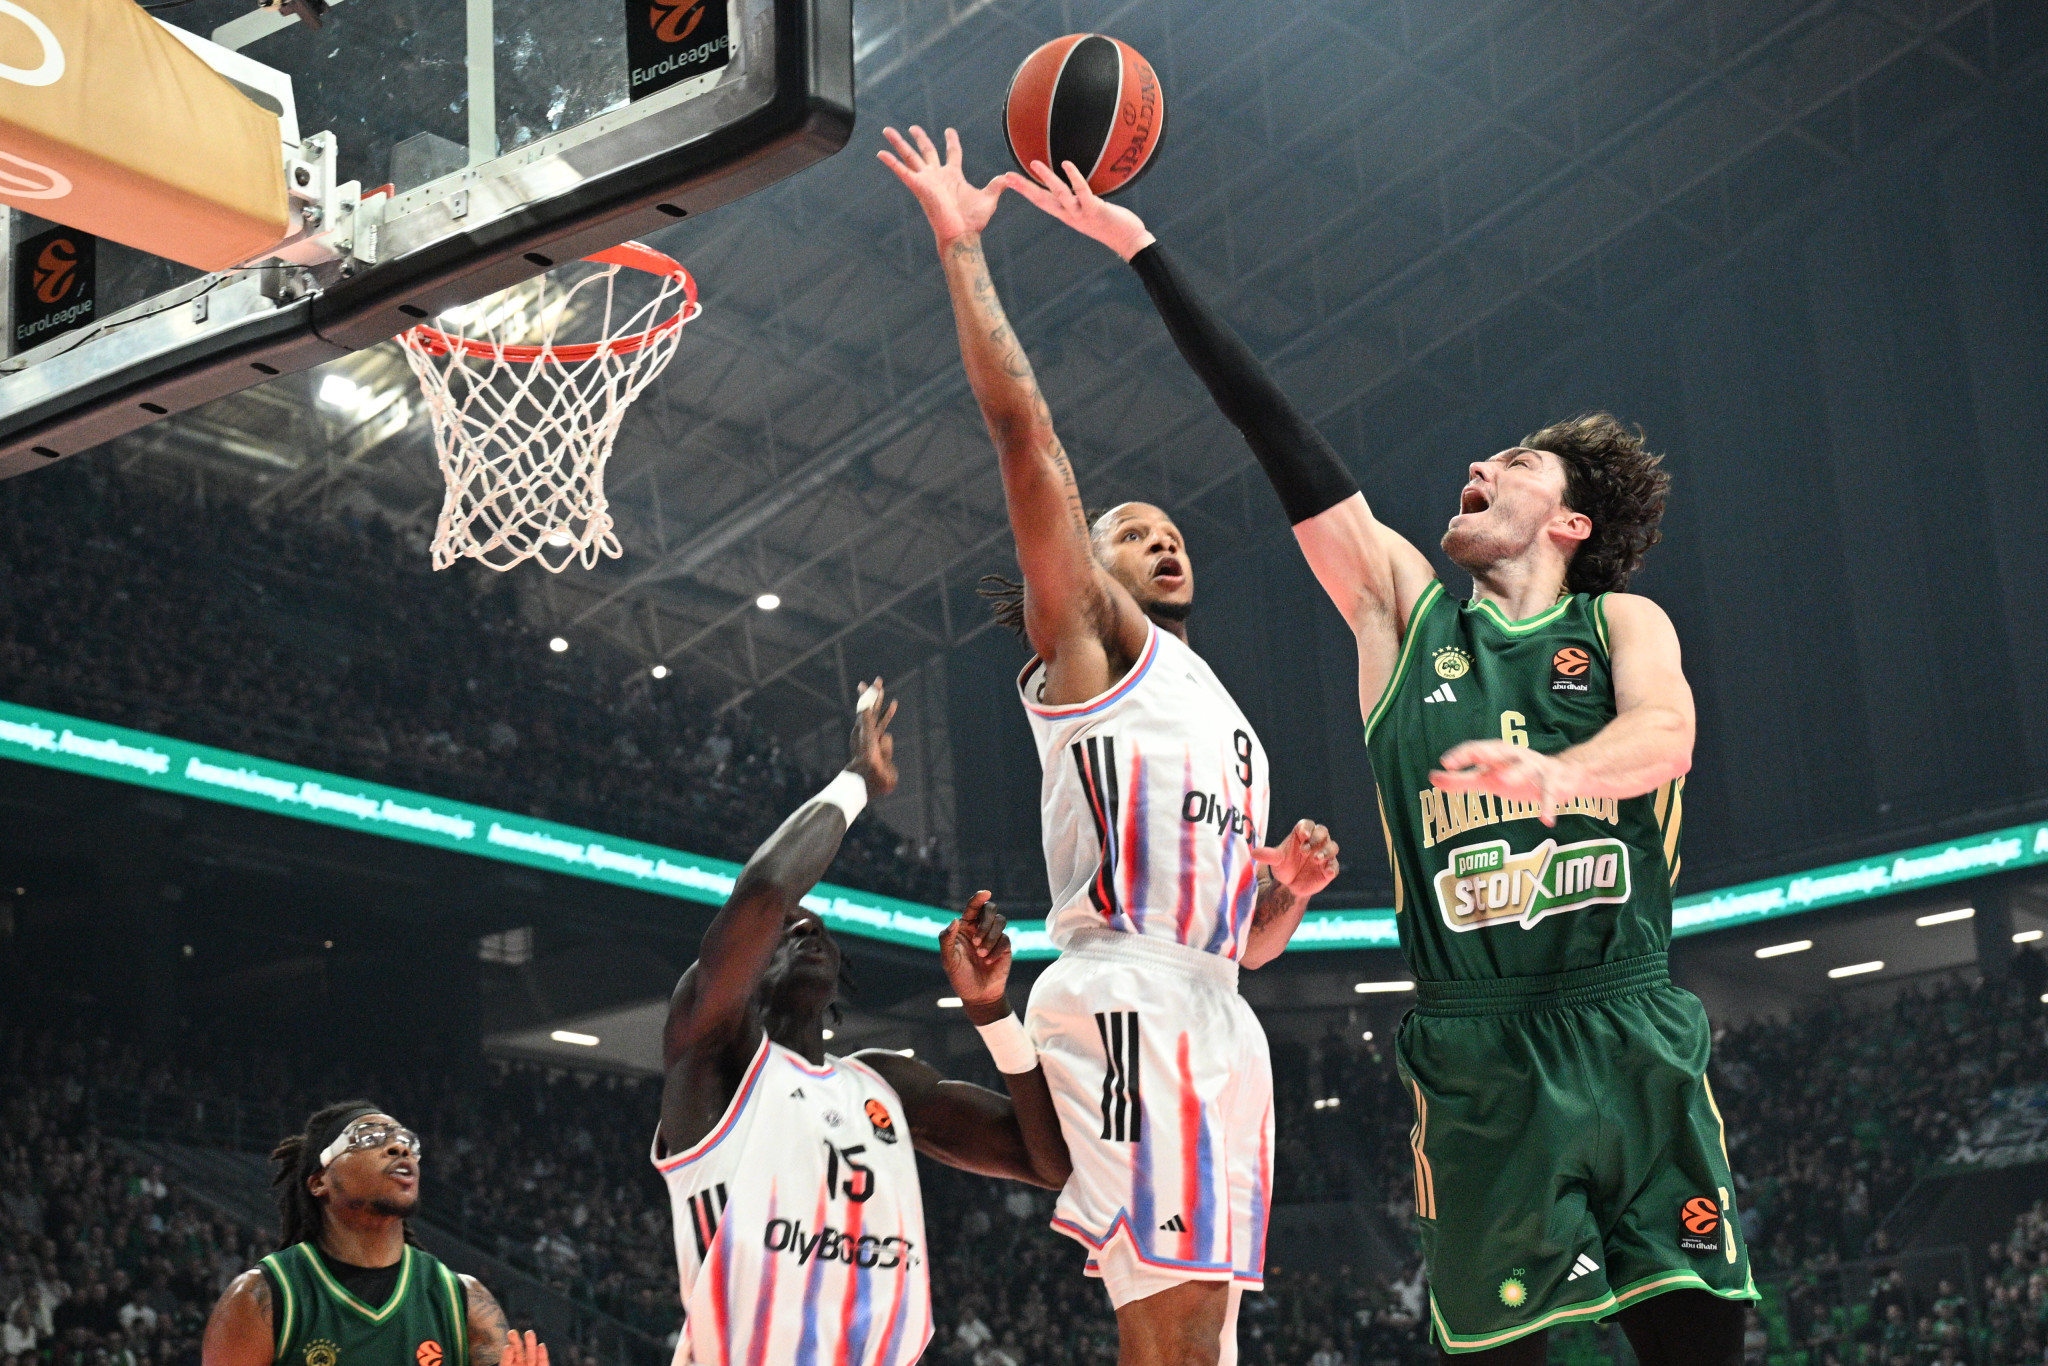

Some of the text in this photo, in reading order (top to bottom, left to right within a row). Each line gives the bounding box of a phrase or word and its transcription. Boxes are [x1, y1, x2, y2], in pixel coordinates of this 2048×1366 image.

[632, 34, 728, 86] EuroLeague
[16, 299, 93, 340] EuroLeague
[1500, 710, 1529, 749] 6
[1233, 728, 1253, 788] 9
[1459, 850, 1499, 875] pame
[823, 1137, 875, 1203] 15
[1512, 1267, 1526, 1277] bp
